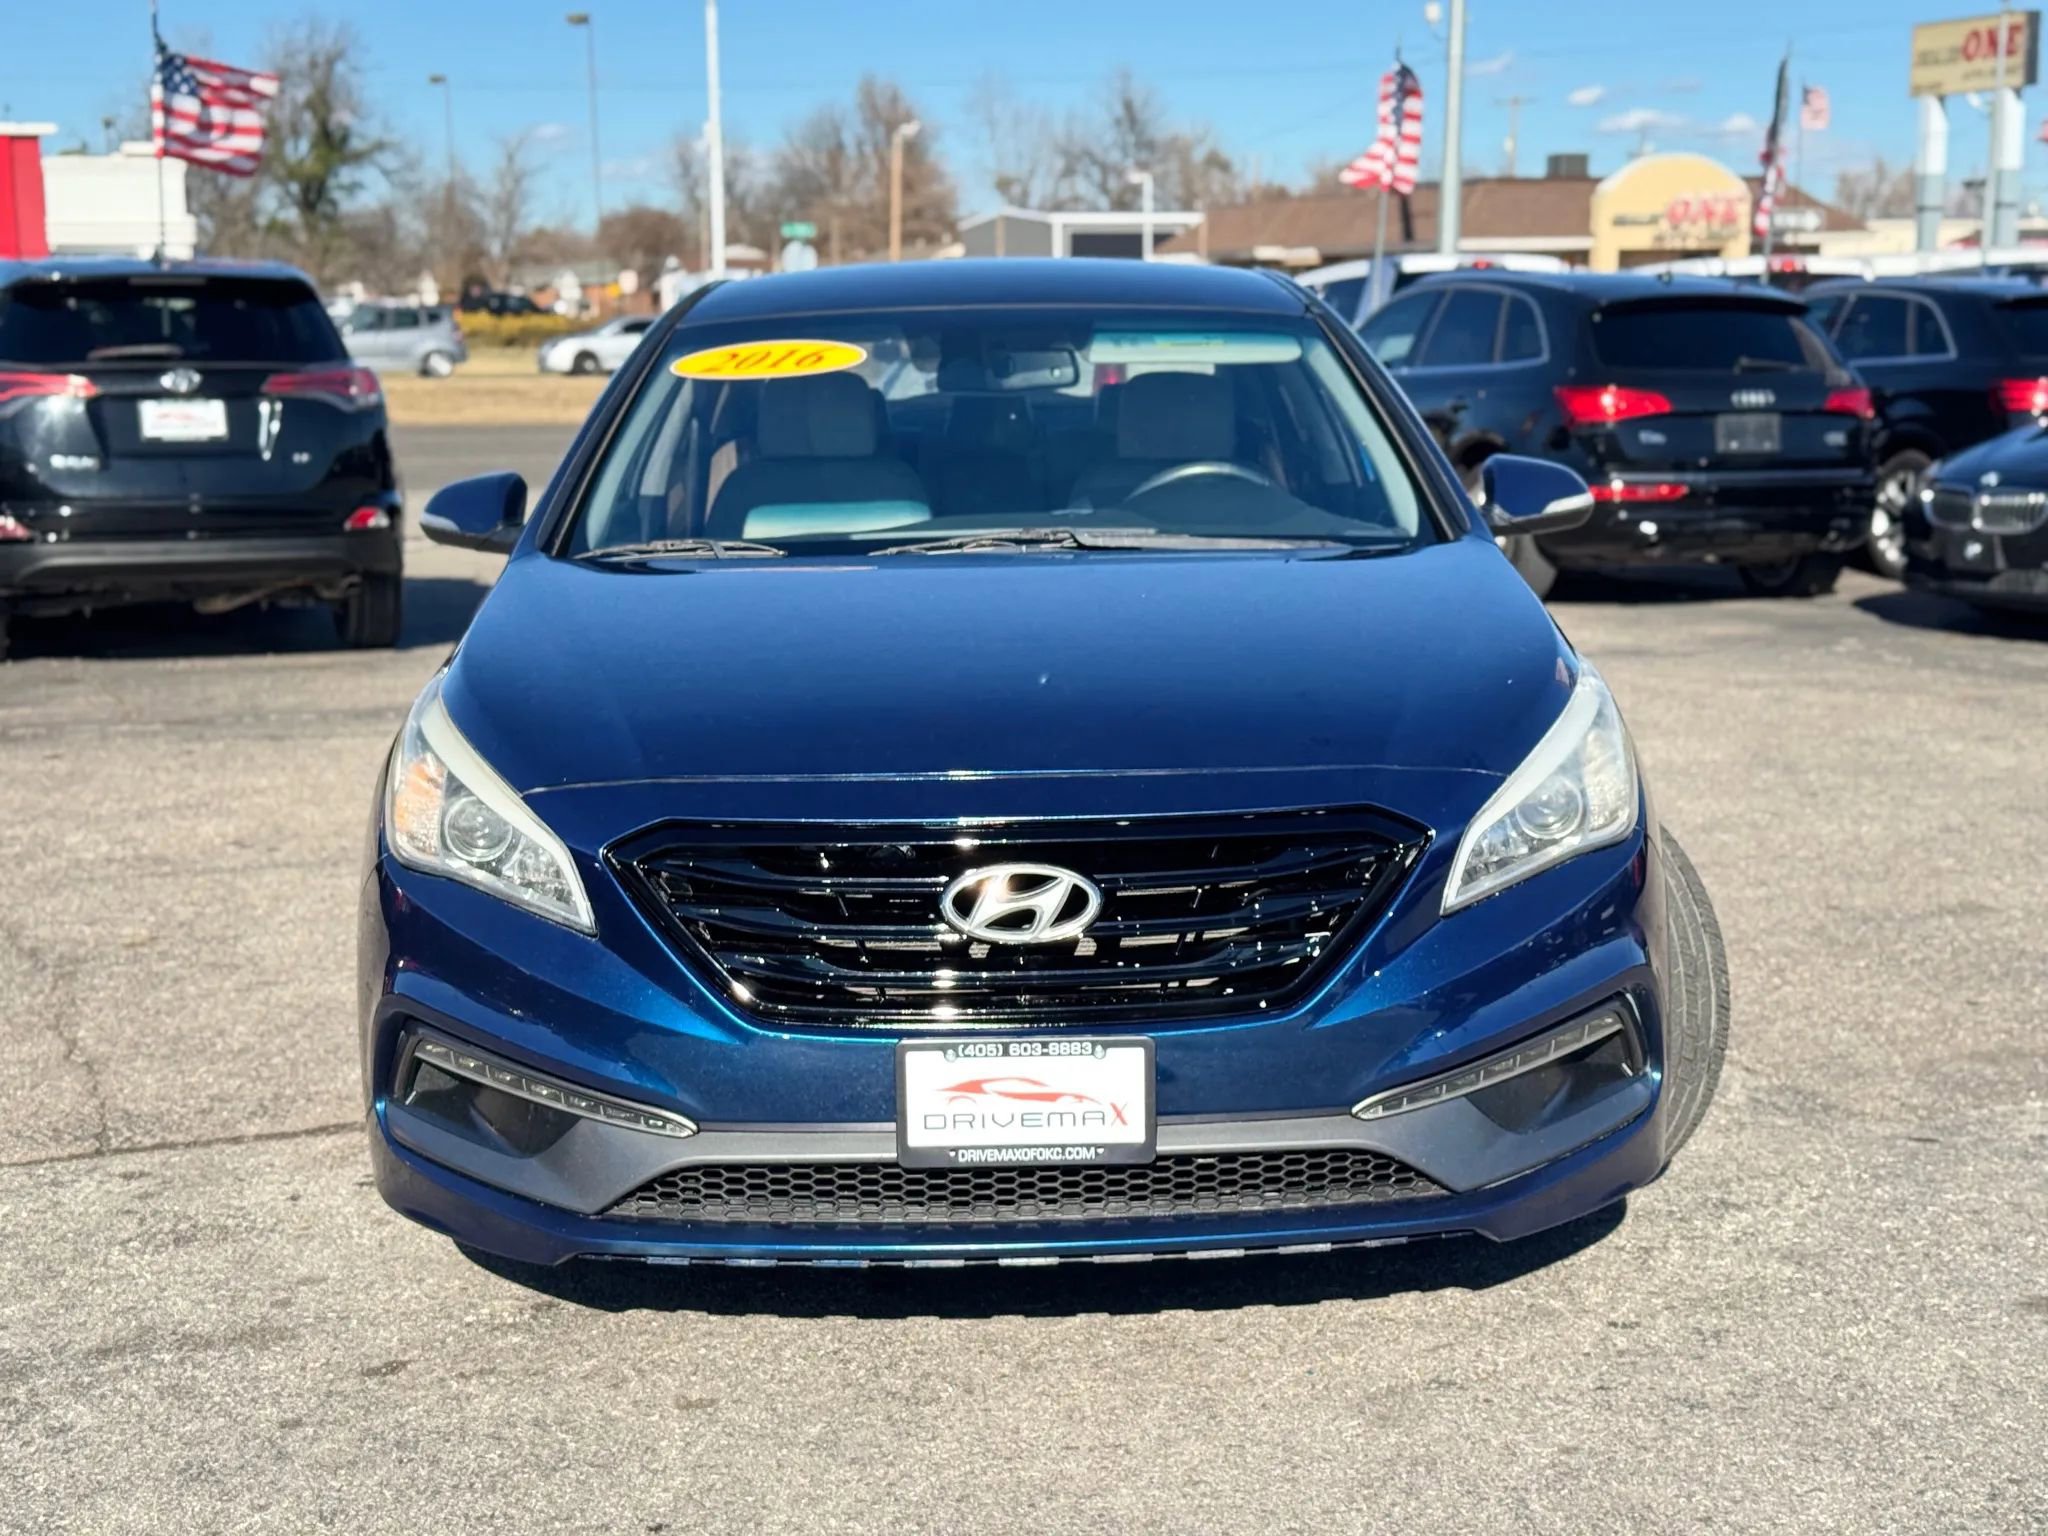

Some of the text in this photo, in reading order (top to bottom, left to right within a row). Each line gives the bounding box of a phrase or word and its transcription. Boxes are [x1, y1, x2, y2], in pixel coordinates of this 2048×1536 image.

[699, 345, 840, 374] 2016
[958, 1043, 1003, 1057] (405)
[924, 1102, 1128, 1130] DRIVEMAX
[958, 1147, 1096, 1163] DRIVEMAXOFOKC.COM
